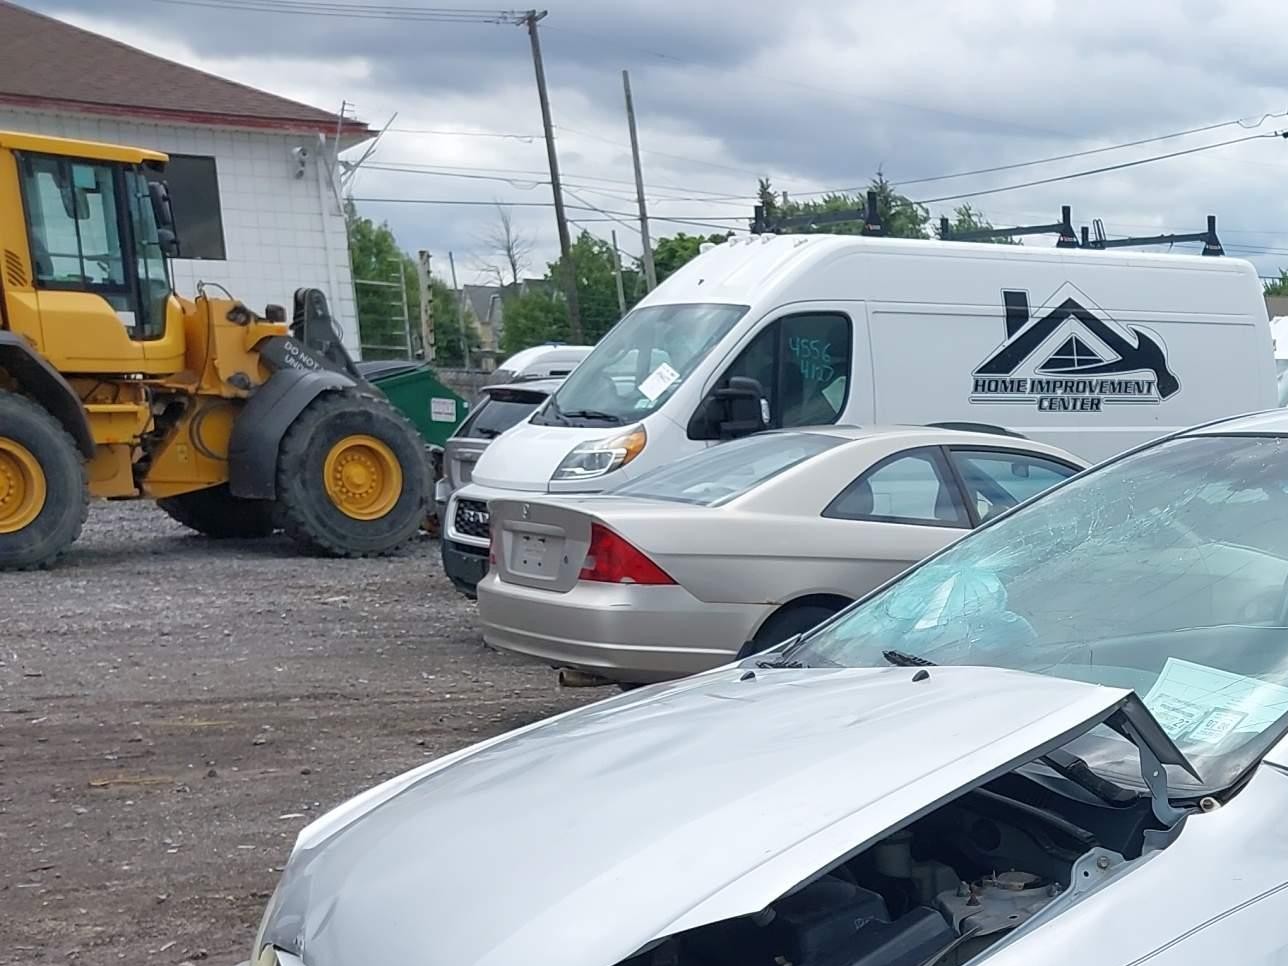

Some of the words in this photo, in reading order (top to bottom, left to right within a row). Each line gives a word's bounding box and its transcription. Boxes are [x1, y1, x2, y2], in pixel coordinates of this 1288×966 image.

[284, 341, 299, 356] DO
[300, 352, 320, 370] NOT
[789, 337, 832, 362] 4556
[973, 379, 1028, 394] HOME
[1029, 379, 1156, 395] IMPROVEMENT
[1038, 396, 1102, 412] CENTER
